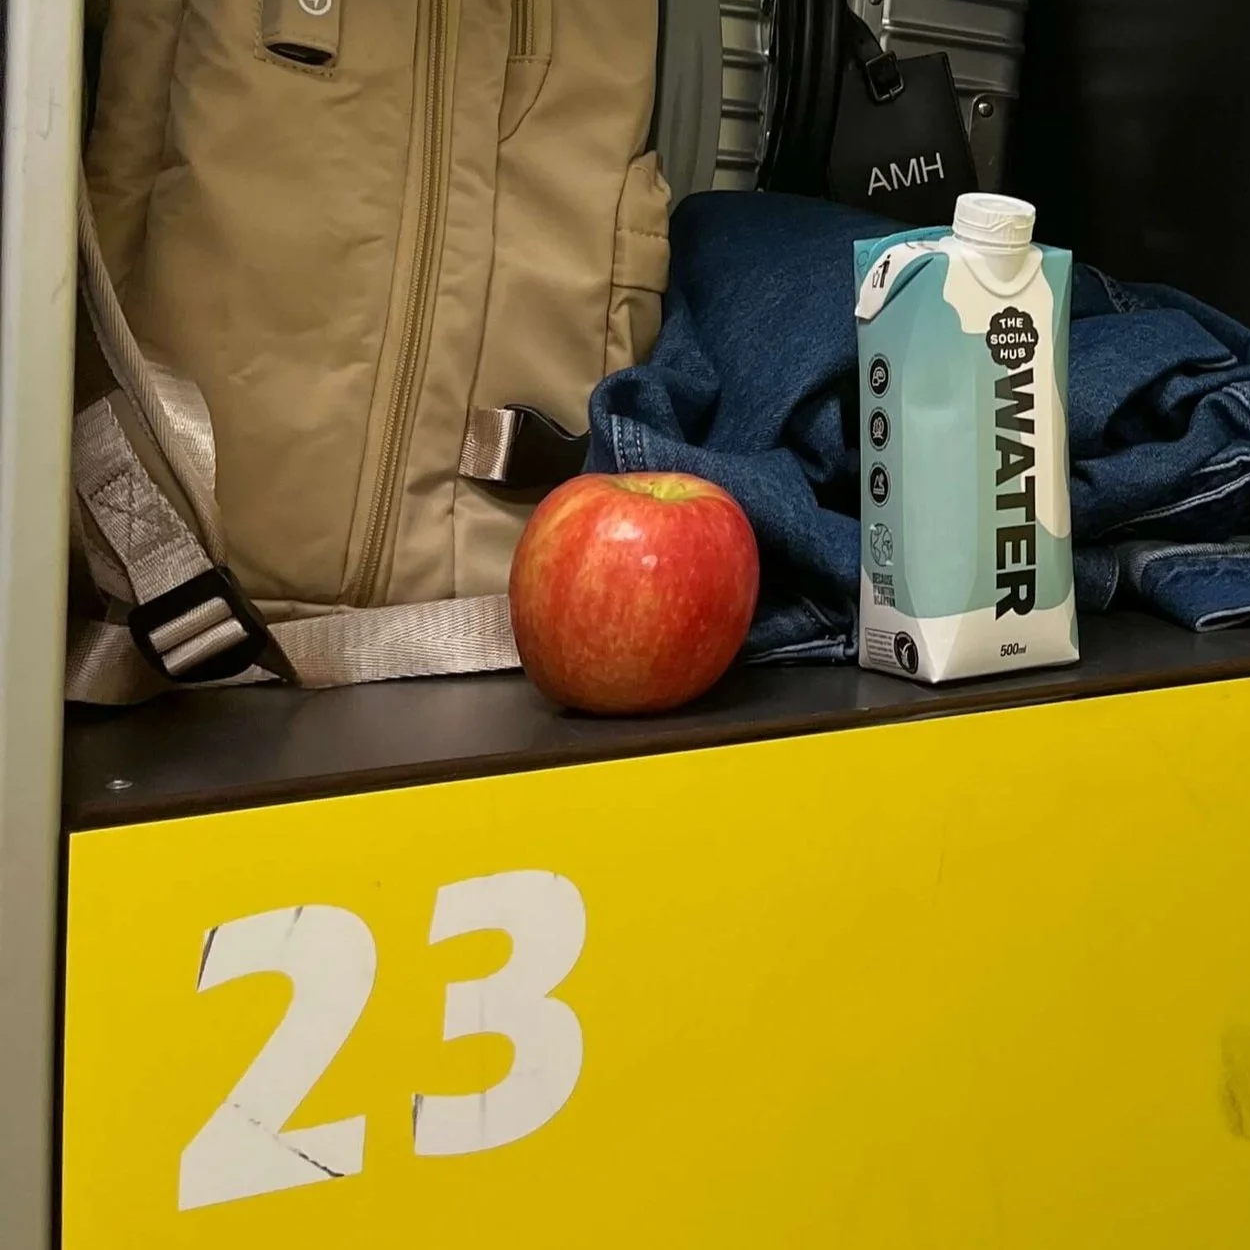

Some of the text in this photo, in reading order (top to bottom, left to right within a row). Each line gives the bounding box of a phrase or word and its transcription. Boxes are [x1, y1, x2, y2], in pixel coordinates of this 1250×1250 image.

[867, 152, 945, 196] AMH
[999, 317, 1024, 329] THE
[990, 332, 1035, 345] SOCIAL
[1000, 347, 1026, 360] HUB
[994, 367, 1037, 621] WATER
[178, 869, 587, 1211] 23
